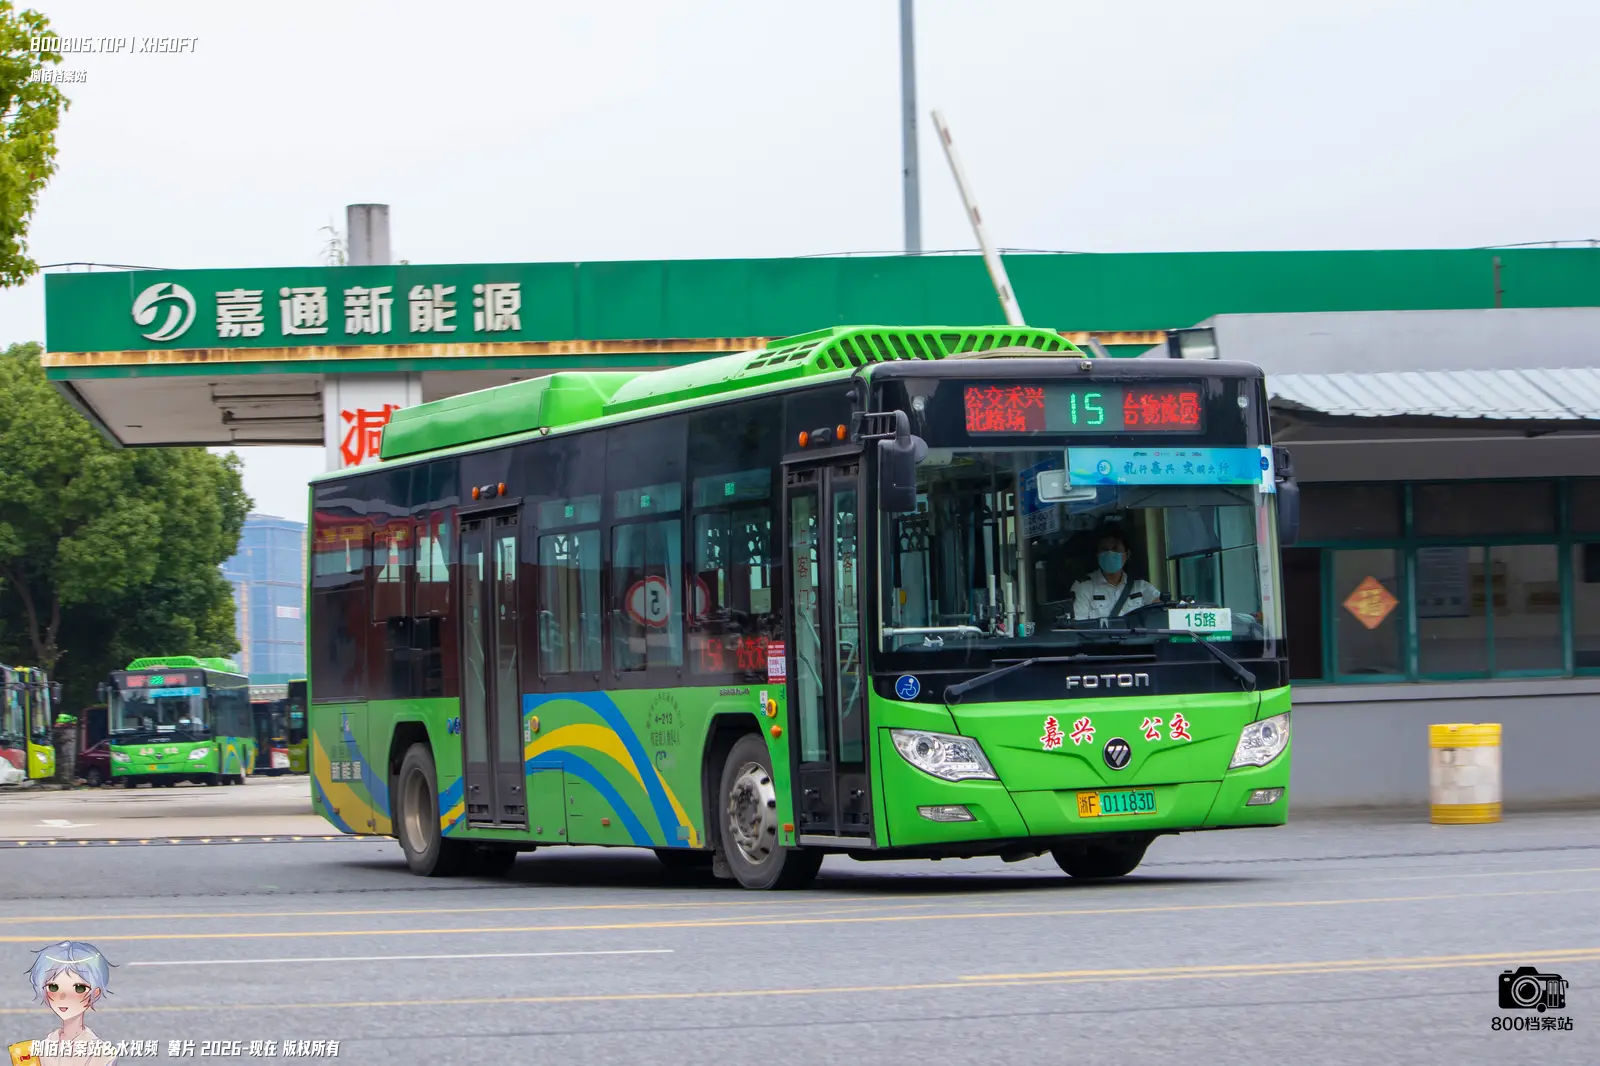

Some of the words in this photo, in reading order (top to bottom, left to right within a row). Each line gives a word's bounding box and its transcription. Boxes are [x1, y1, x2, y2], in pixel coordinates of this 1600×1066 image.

[215, 282, 522, 338] 嘉通新能源
[964, 386, 1045, 409] 公交禾兴
[1070, 393, 1105, 425] 15
[1185, 612, 1216, 627] 15路
[1066, 673, 1150, 689] FOTON
[1040, 716, 1096, 750] 嘉兴
[1140, 712, 1192, 742] 公交
